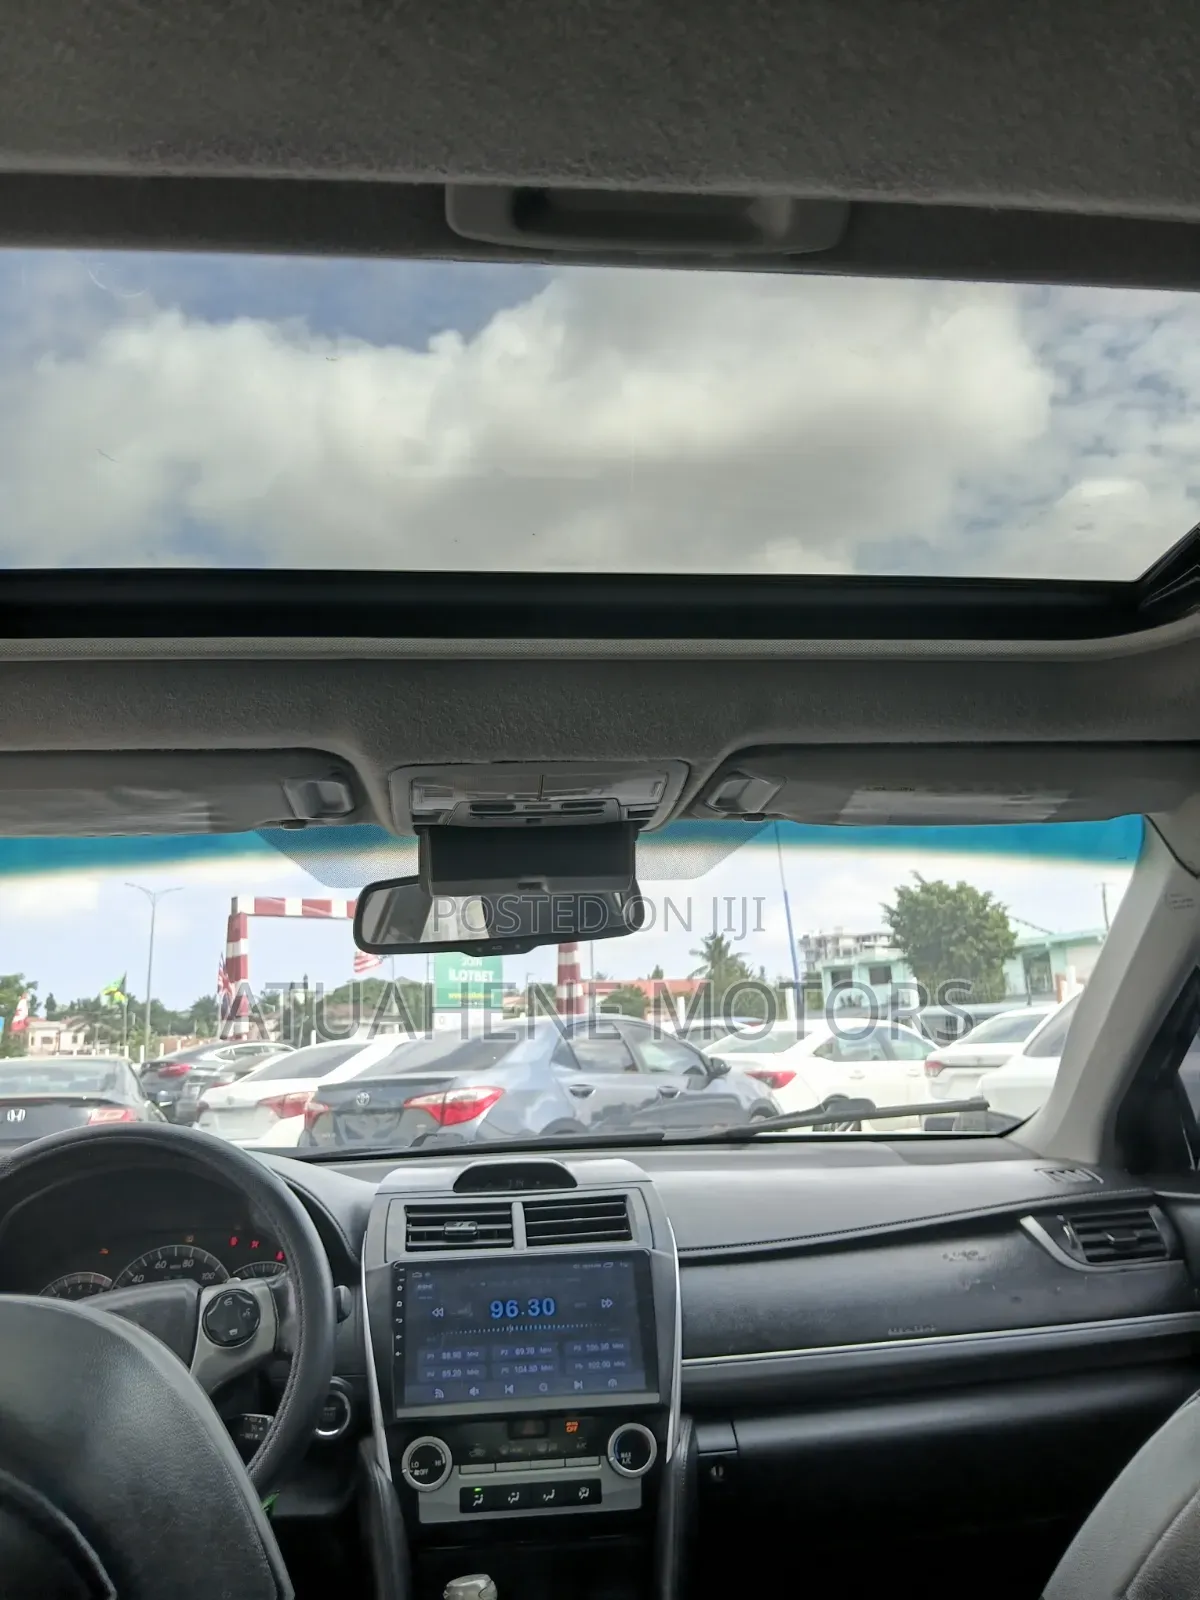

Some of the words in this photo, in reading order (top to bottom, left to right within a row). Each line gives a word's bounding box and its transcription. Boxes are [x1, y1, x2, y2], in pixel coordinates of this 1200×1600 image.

[154, 1260, 167, 1269] 60
[182, 1259, 194, 1268] 80
[131, 1274, 145, 1283] 40
[201, 1272, 216, 1280] 100
[489, 1297, 556, 1320] 96.30
